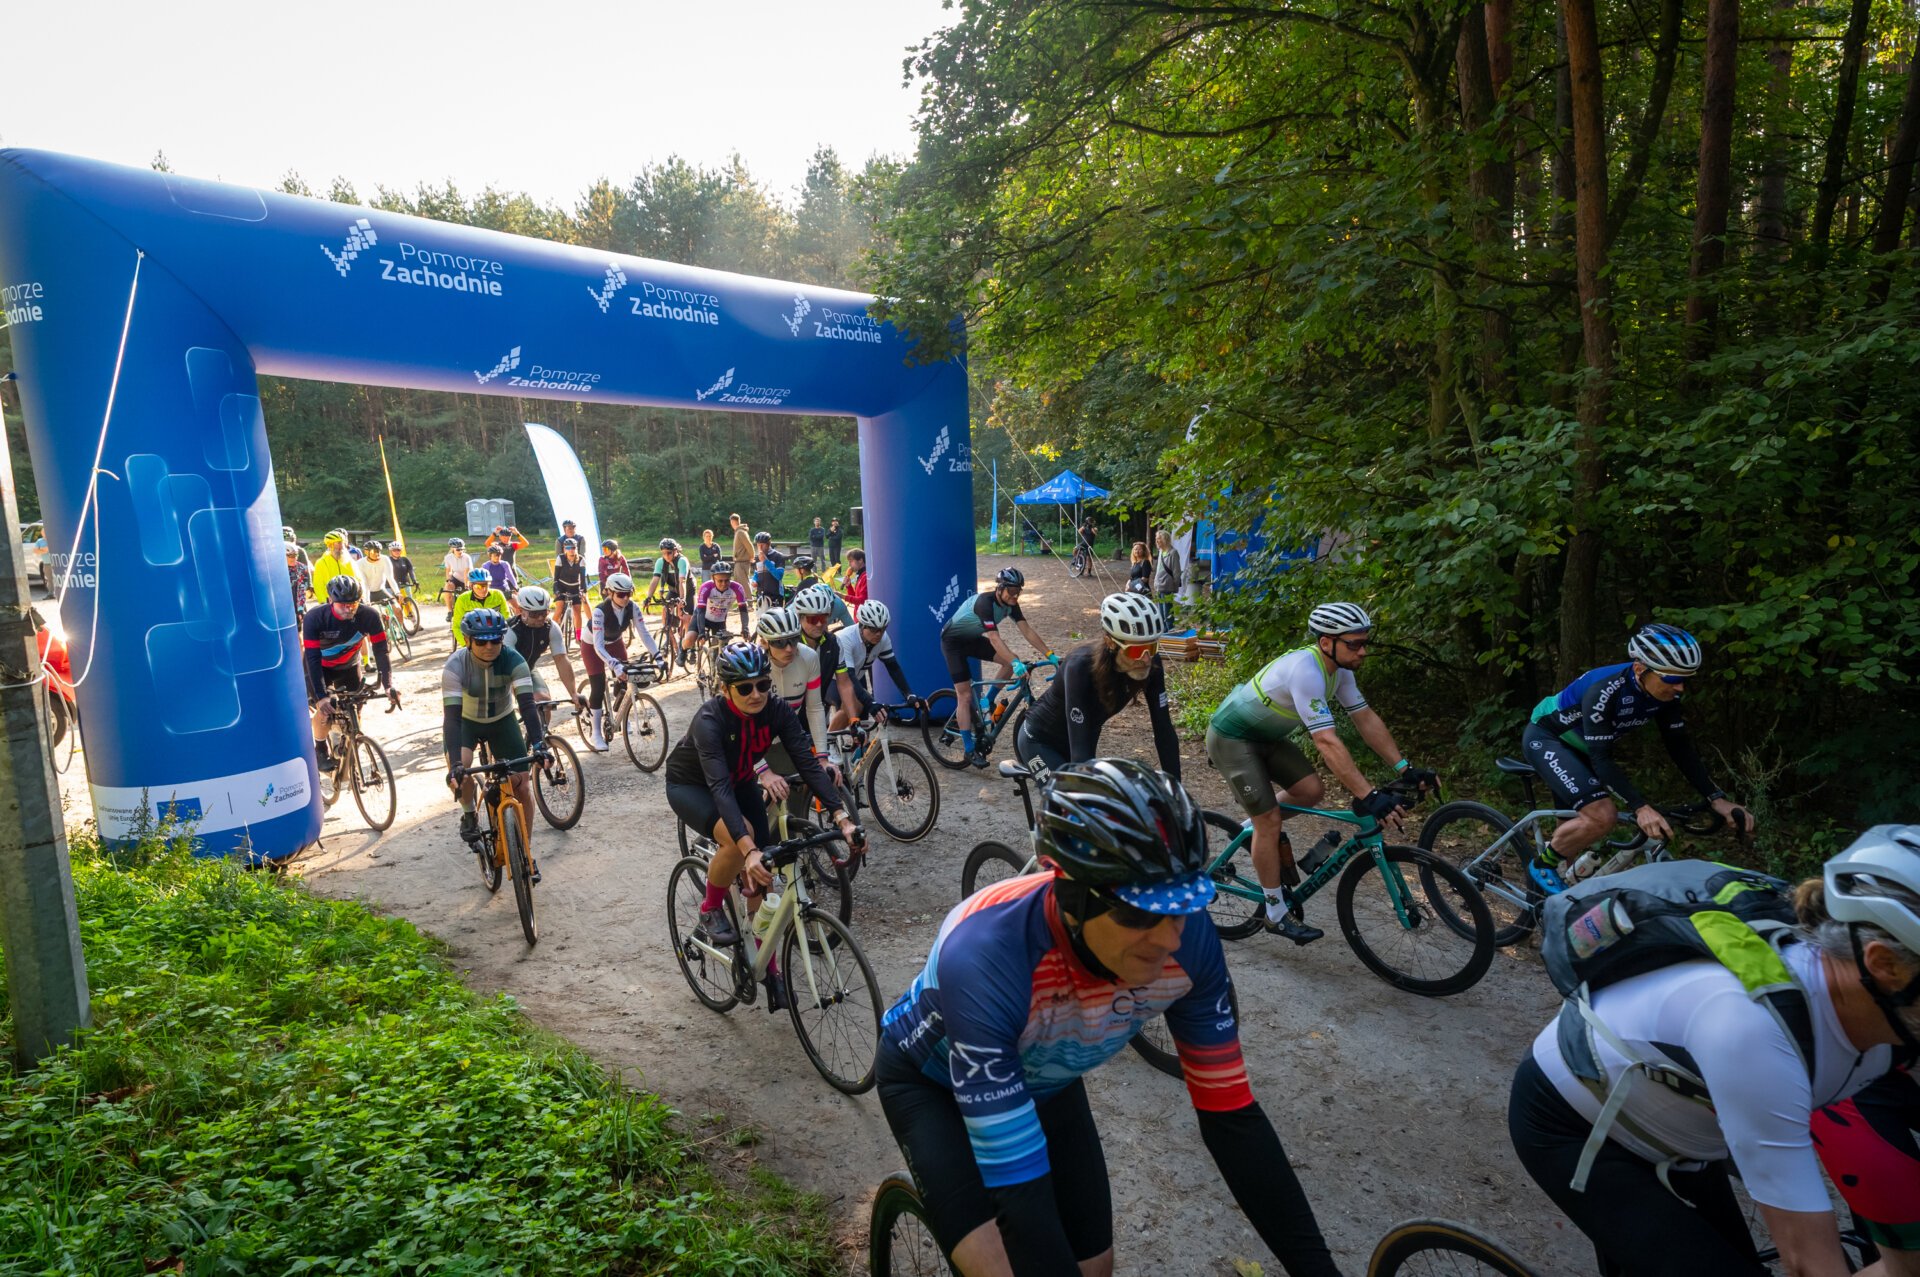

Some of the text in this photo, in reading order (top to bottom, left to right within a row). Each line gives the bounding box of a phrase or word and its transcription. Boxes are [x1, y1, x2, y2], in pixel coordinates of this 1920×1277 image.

[399, 242, 503, 276] Pomorze
[379, 259, 502, 296] Zachodnie
[641, 281, 719, 308] Pomorze
[629, 297, 719, 326] Zachodnie
[814, 321, 882, 344] Zachodnie
[507, 376, 592, 392] Zachodnie
[529, 365, 601, 383] Pomorze
[718, 392, 782, 406] Zachodnie
[736, 382, 791, 398] Pomorze
[1592, 676, 1625, 712] baloise
[1548, 758, 1580, 794] baloise
[984, 1081, 1024, 1102] CLIMATE
